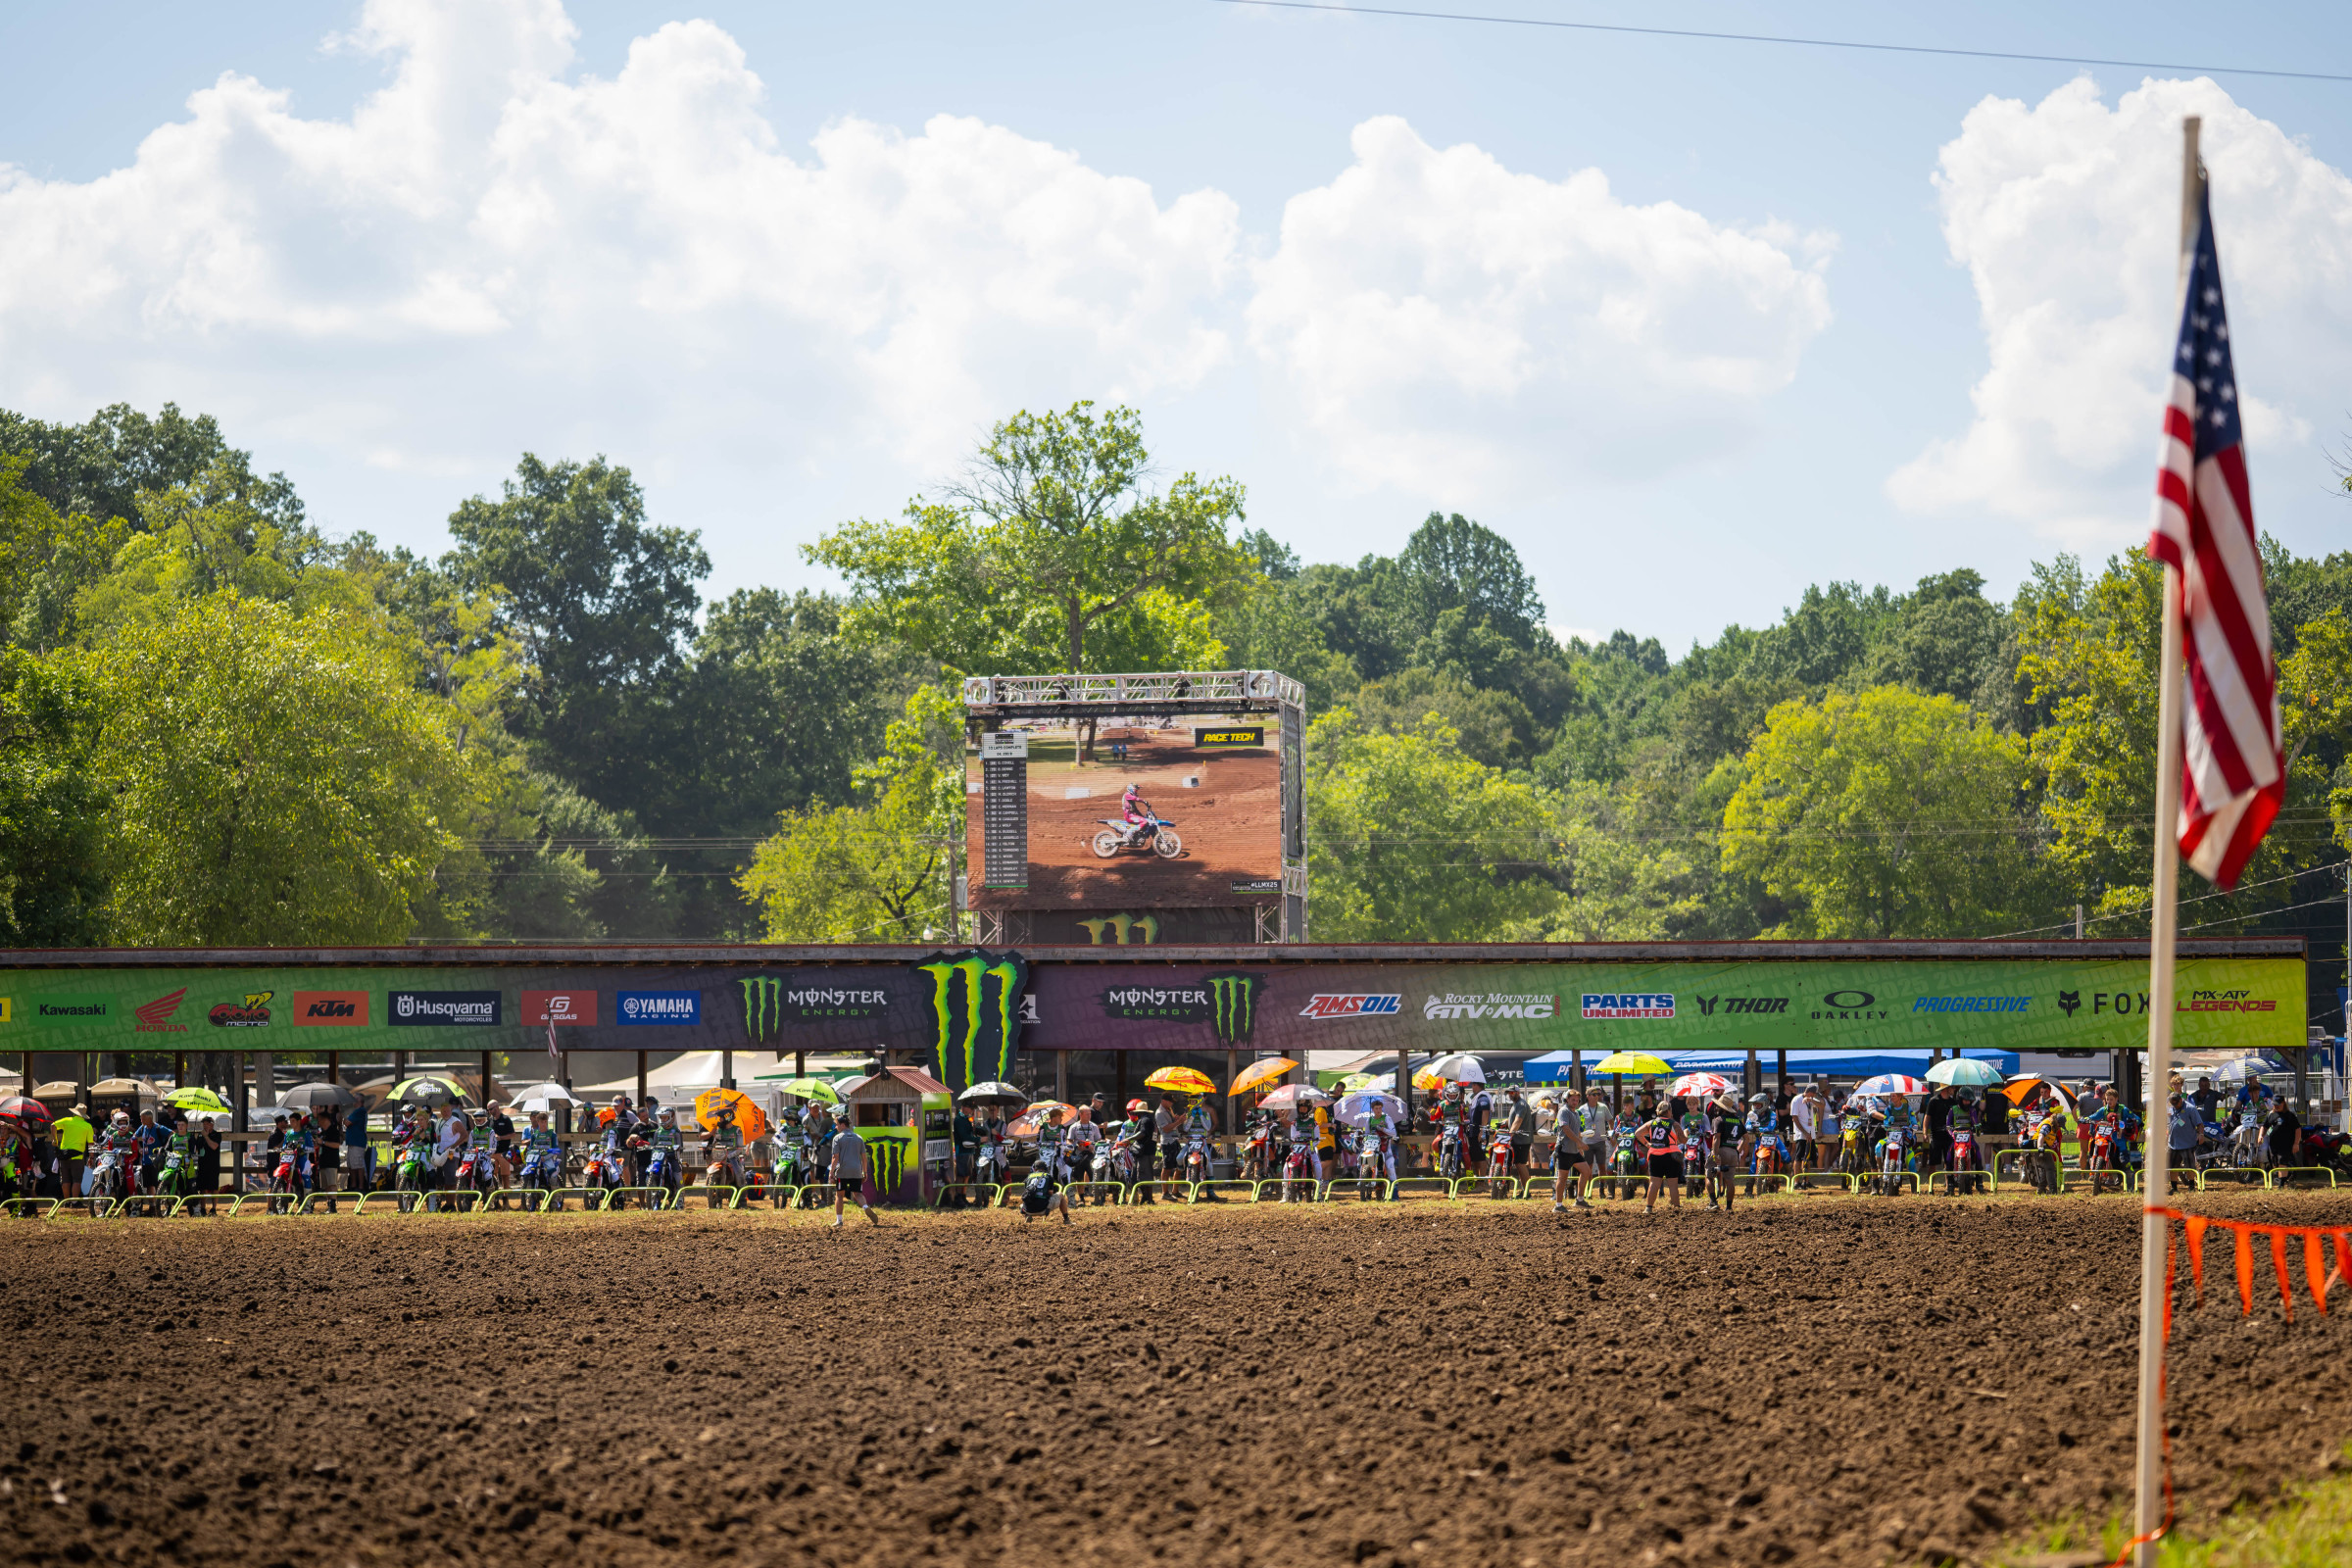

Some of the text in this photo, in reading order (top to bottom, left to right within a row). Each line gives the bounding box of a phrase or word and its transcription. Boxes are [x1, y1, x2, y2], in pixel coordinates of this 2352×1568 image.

[1203, 732, 1255, 743] RACE TECH
[1934, 965, 1995, 991] 2025
[1869, 975, 1929, 1000] 2025
[787, 987, 888, 1006] MONSTER
[1109, 989, 1208, 1006] MONSTER
[1444, 993, 1554, 1004] ROCKY MOUNTAIN
[2192, 990, 2216, 1000] MX
[2223, 990, 2251, 1000] ATV
[640, 999, 694, 1013] YAMAHA
[1301, 994, 1400, 1017] AMSOIL
[1582, 994, 1675, 1008] PARTS
[1724, 997, 1789, 1013] THOR
[1912, 996, 2034, 1013] PROGRESSIVE
[2093, 992, 2150, 1015] FOX
[2176, 1000, 2277, 1013] LEGENDS
[39, 1004, 107, 1016] Kawasaki
[307, 1001, 356, 1016] KTM
[416, 1000, 493, 1016] Husqvarna
[1582, 1008, 1675, 1018] UNLIMITED
[209, 1004, 271, 1026] Cobra
[1810, 1010, 1888, 1020] OAKLEY
[1672, 1014, 1732, 1038] 2025
[178, 1094, 212, 1102] Kawasaki
[796, 1088, 829, 1099] Kawasaki
[2242, 1114, 2256, 1123] 23
[1445, 1126, 1458, 1135] 21
[1652, 1127, 1666, 1140] 13
[1731, 1125, 1739, 1137] 4
[1495, 1135, 1510, 1144] 72
[1686, 1137, 1699, 1146] 42
[1761, 1136, 1776, 1145] 55
[1956, 1133, 1970, 1142] 58
[1096, 1146, 1110, 1154] 94
[1292, 1145, 1306, 1153] 37
[280, 1154, 294, 1163] 59
[407, 1152, 419, 1160] 51
[652, 1152, 665, 1160] 90
[780, 1151, 795, 1159] 25
[167, 1158, 180, 1168] 46
